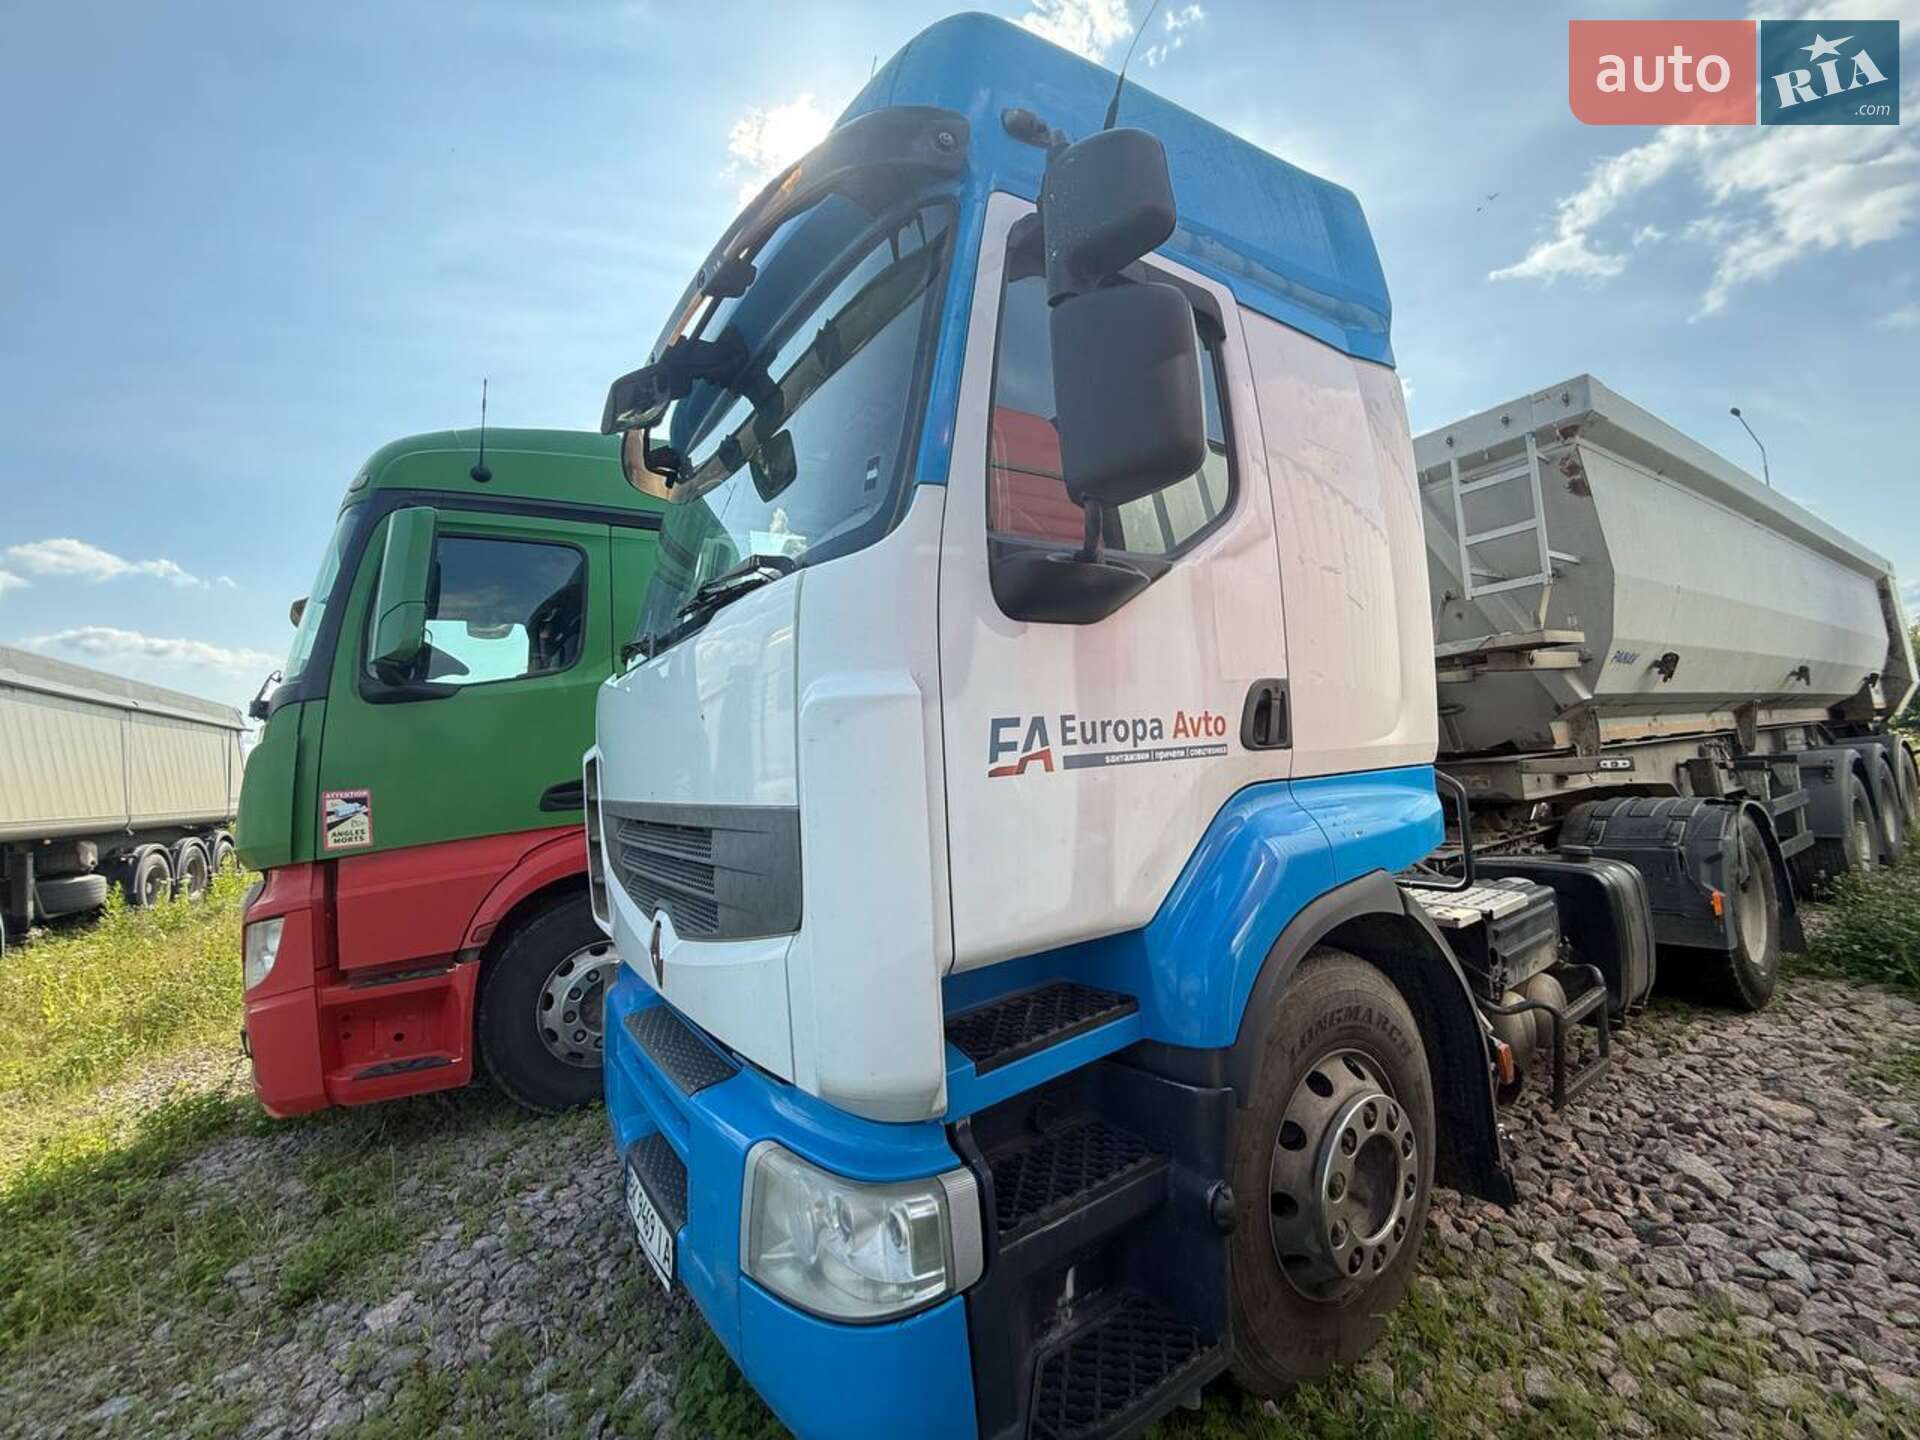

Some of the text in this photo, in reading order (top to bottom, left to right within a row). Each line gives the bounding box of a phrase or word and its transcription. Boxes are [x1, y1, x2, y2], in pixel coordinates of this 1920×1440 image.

[1060, 714, 1164, 748] Europa
[1172, 710, 1226, 739] Avto
[331, 829, 366, 838] ANGLES
[333, 836, 365, 844] MORTS
